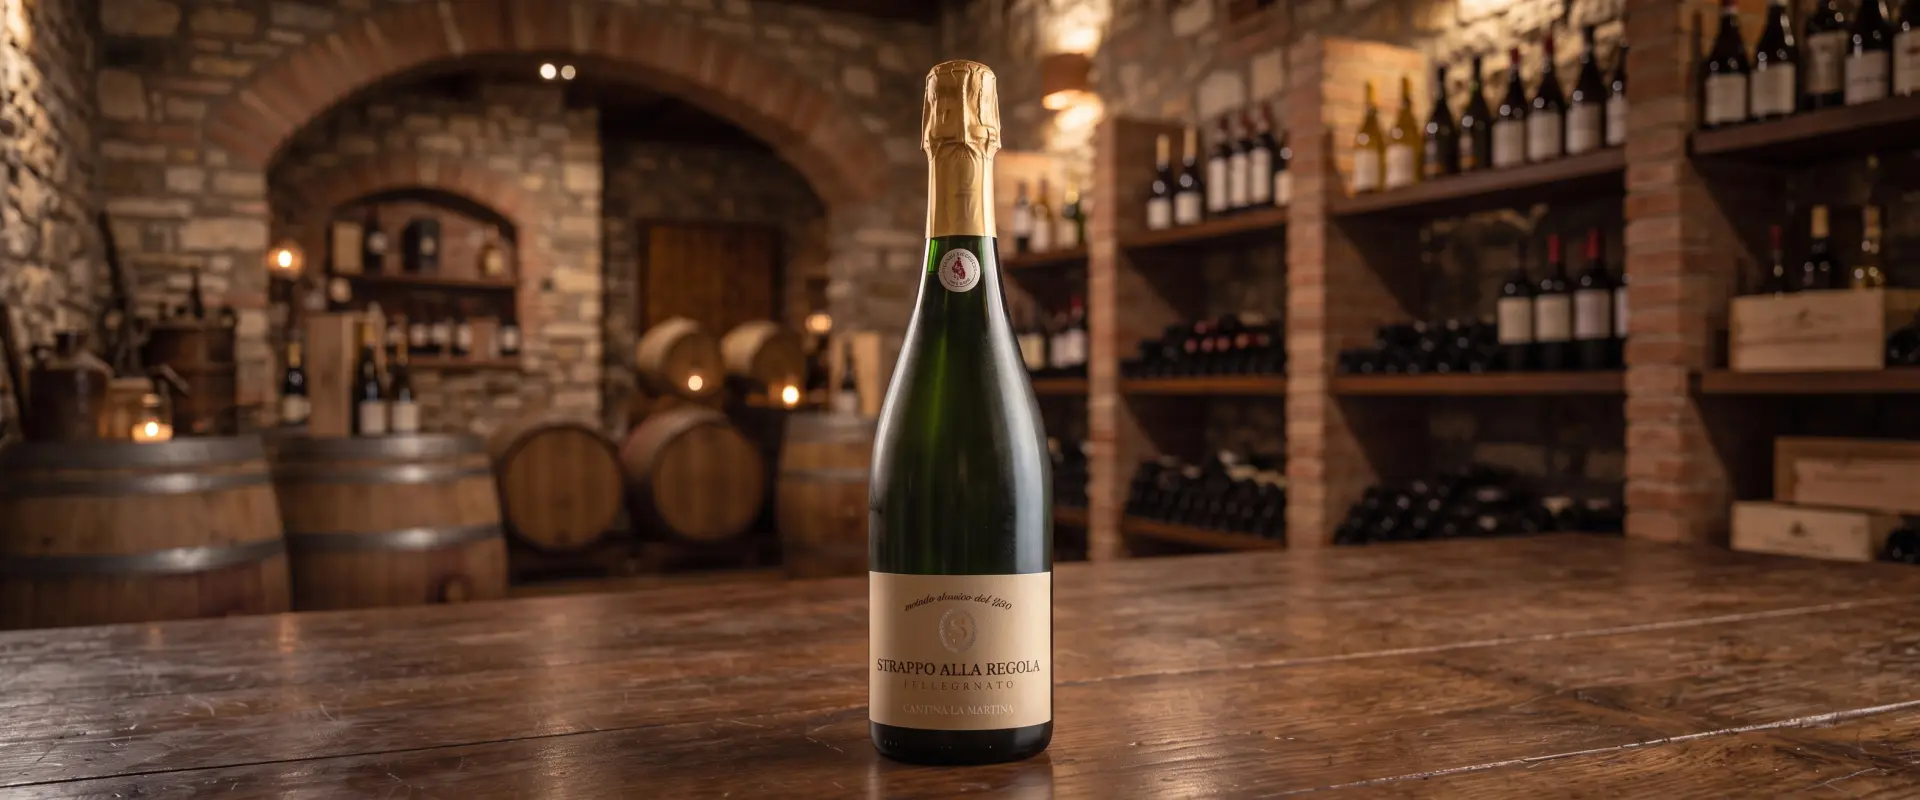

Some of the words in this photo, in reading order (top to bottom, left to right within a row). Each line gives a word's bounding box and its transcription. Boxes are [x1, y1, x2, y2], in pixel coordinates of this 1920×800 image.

[877, 658, 936, 676] STRAPPO
[939, 663, 982, 677] ALLA
[986, 660, 1040, 676] REGOLA
[903, 703, 949, 715] CANTINA
[950, 705, 964, 716] LA
[967, 703, 1014, 716] MARTINA
